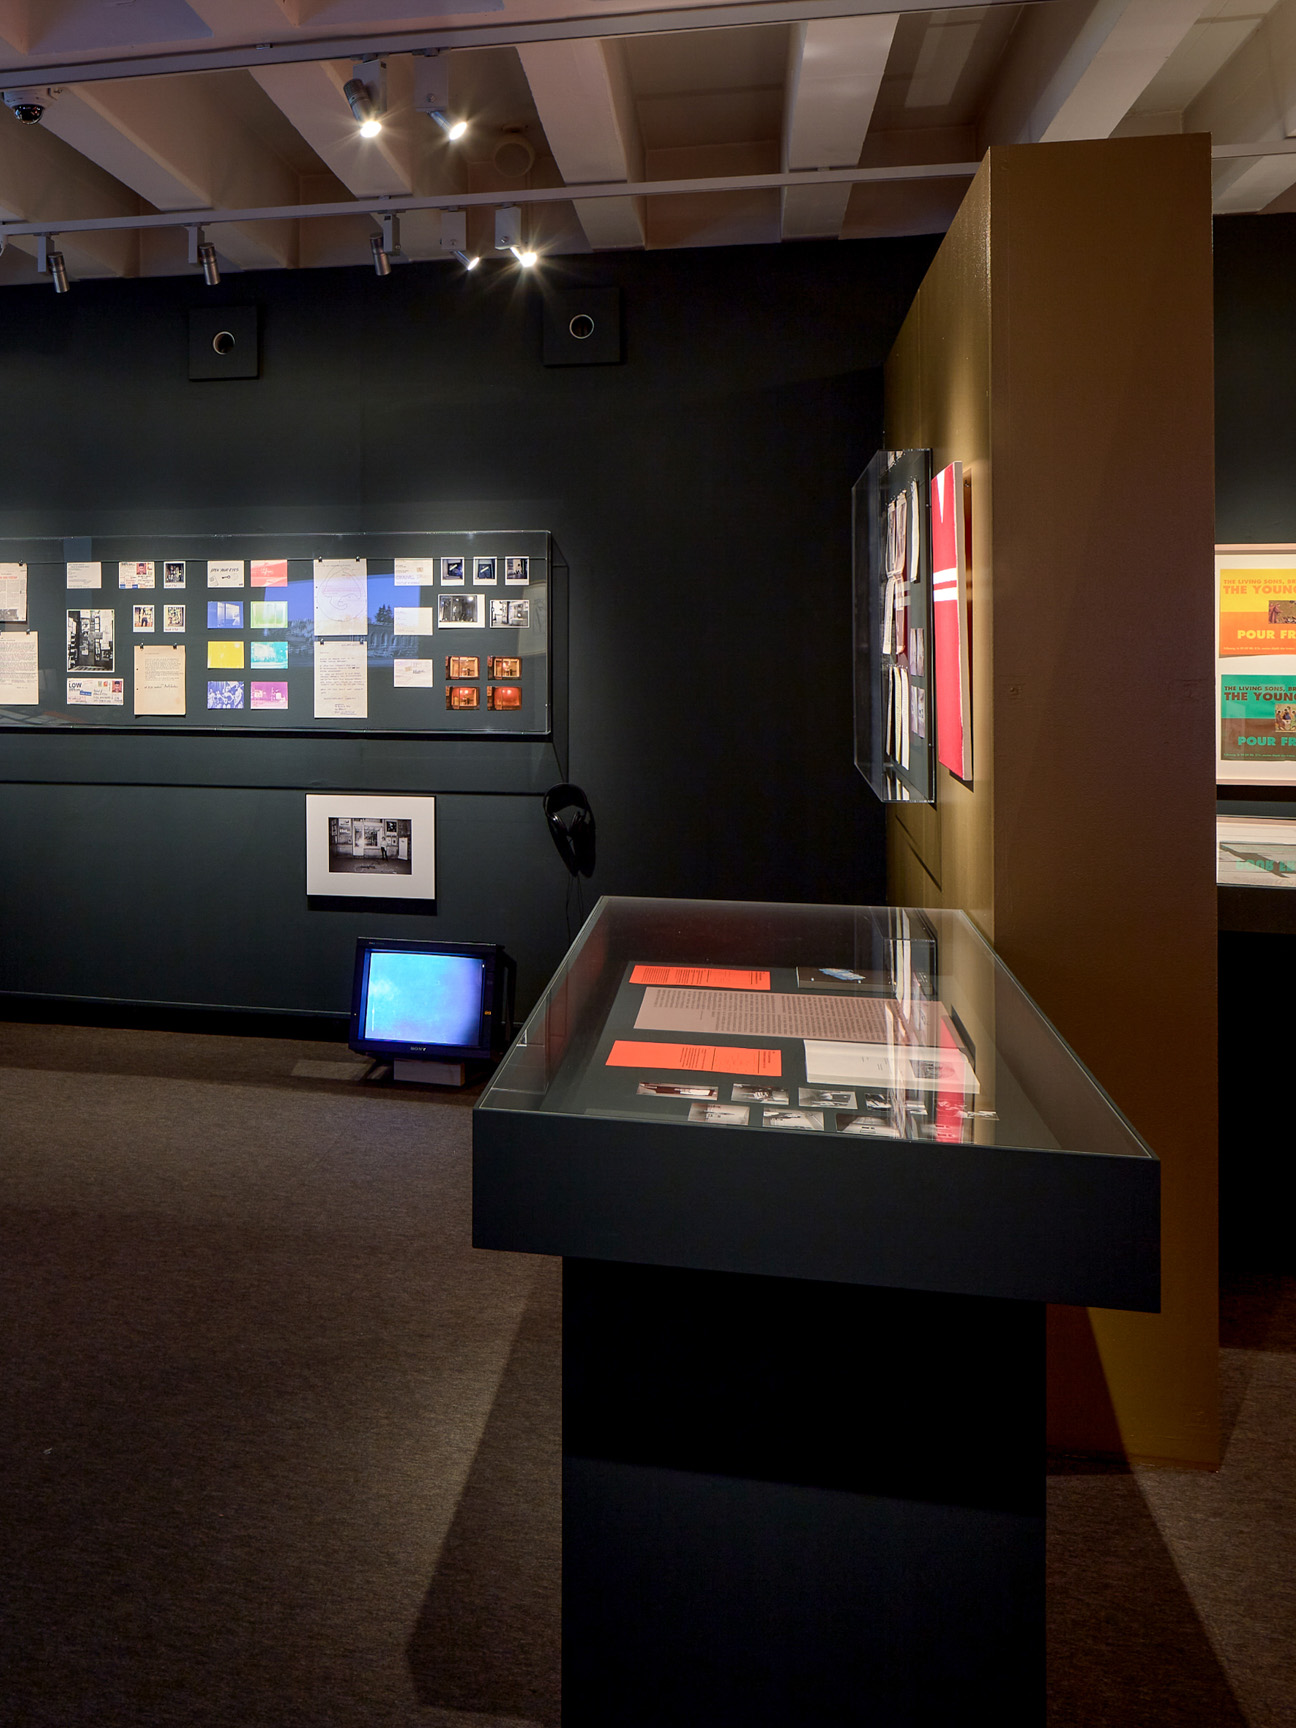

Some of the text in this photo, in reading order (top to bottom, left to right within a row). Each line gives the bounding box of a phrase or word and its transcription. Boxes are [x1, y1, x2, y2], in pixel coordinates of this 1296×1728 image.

[1223, 585, 1296, 594] THE YOUN
[1237, 630, 1275, 639] POUR
[1224, 692, 1296, 701] THE YOUN
[1238, 736, 1276, 746] POUR
